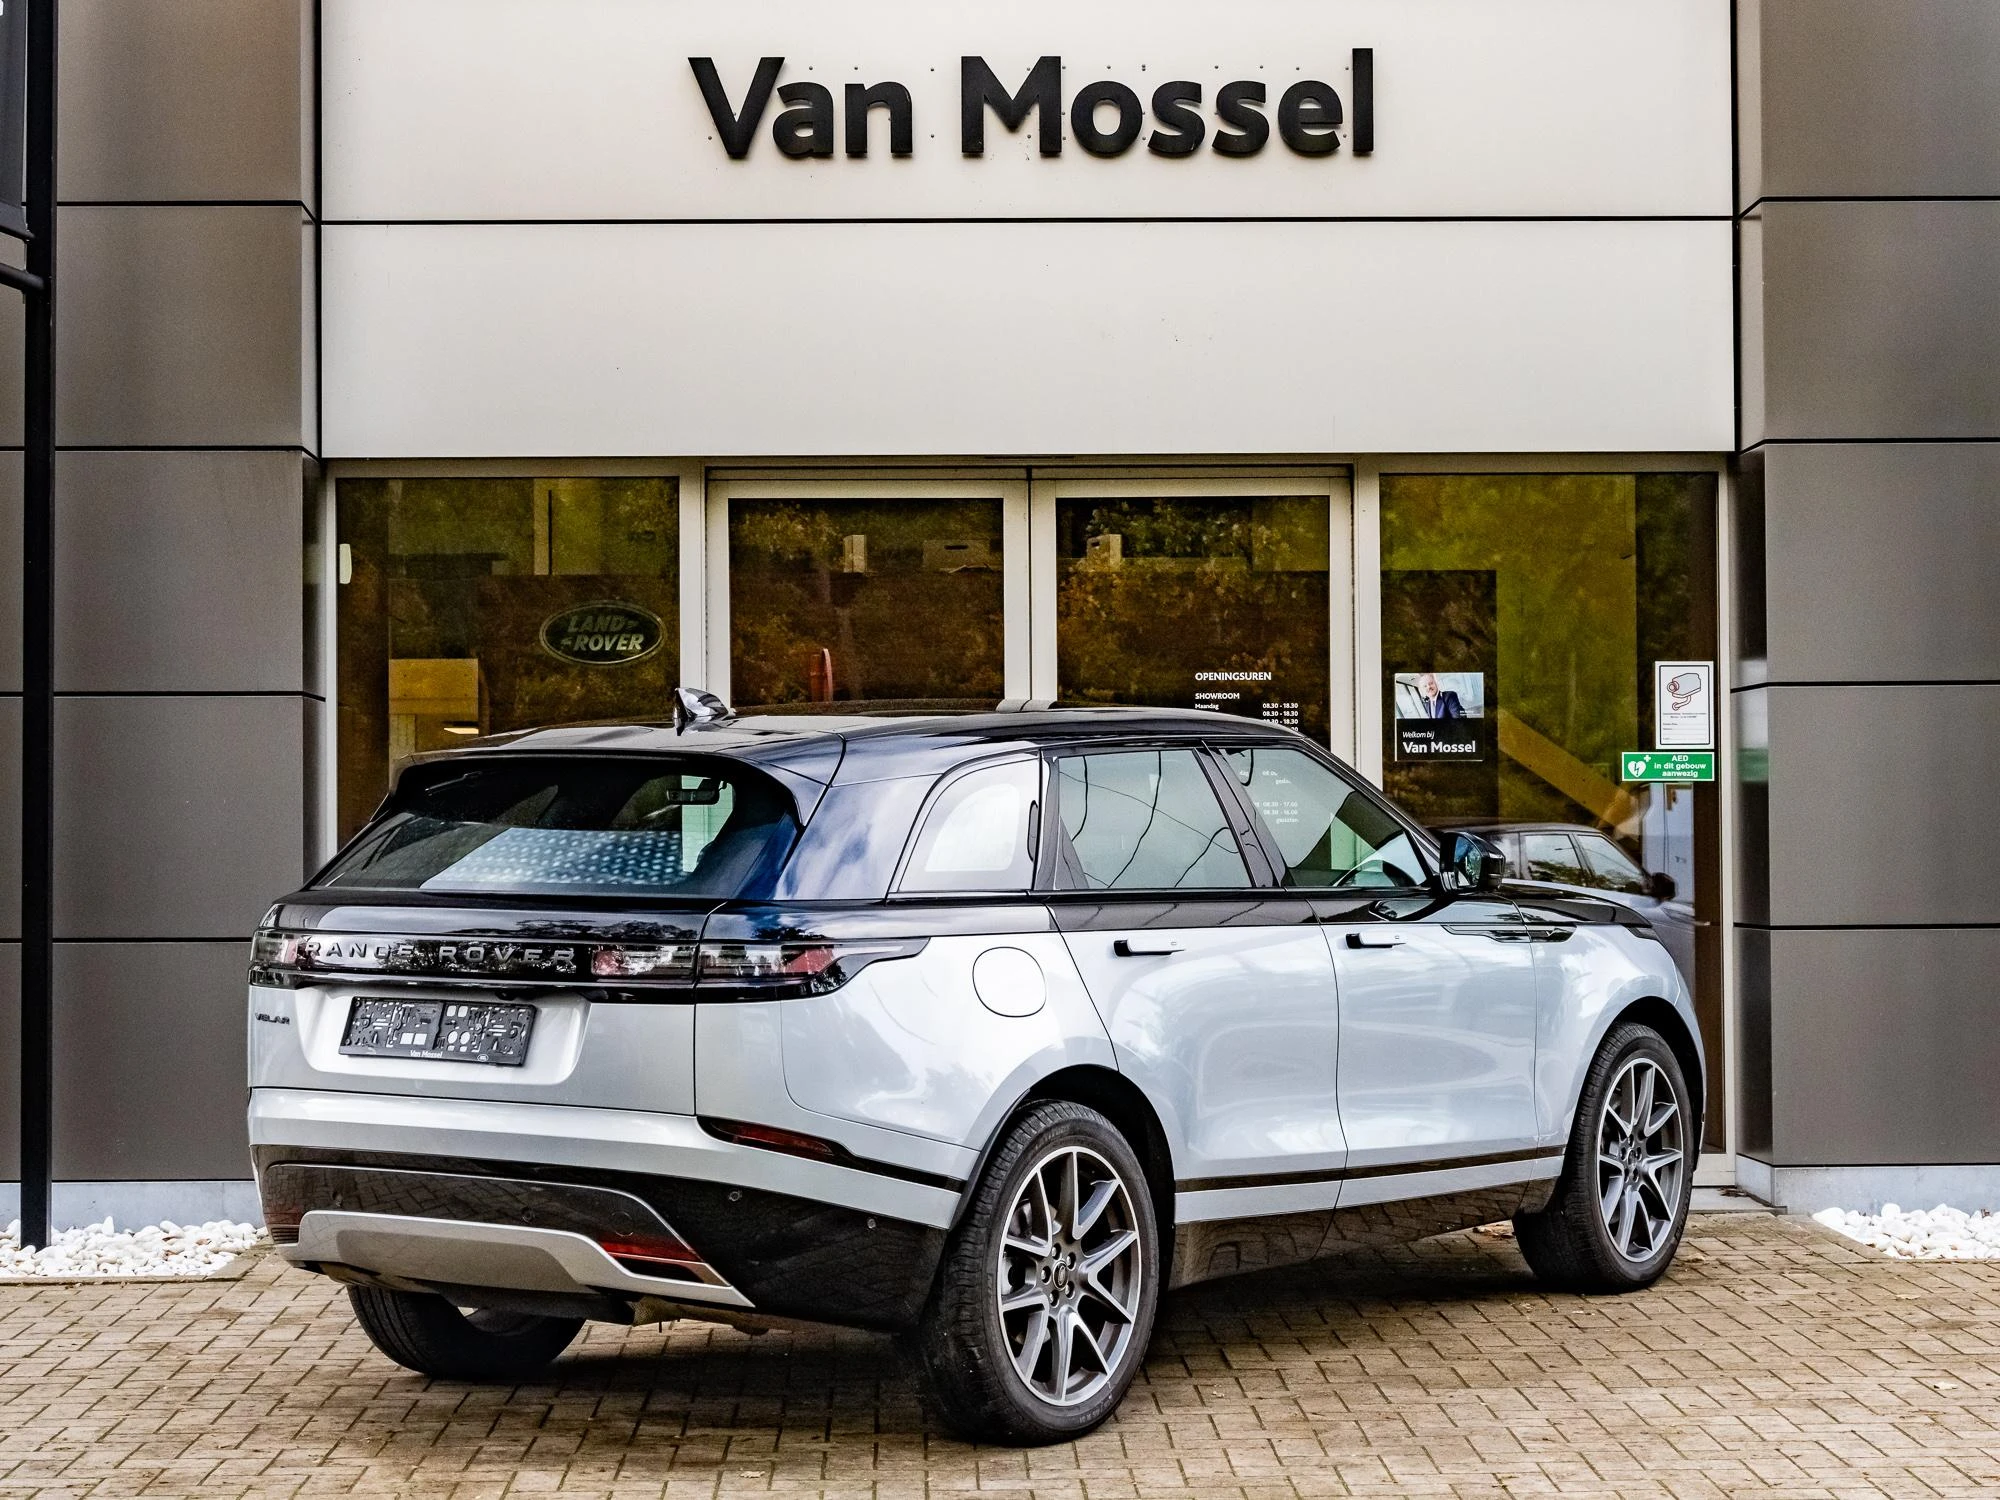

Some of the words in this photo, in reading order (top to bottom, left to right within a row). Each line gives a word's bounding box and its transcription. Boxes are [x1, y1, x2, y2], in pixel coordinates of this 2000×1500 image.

[687, 55, 914, 158] Van
[961, 47, 1374, 158] Mossel
[567, 615, 625, 632] LAND
[573, 633, 645, 651] ROVER
[1194, 671, 1272, 681] OPENINGSUREN
[1194, 692, 1240, 700] SHOWROOM
[1402, 731, 1426, 739] Welkom
[1426, 731, 1435, 740] bij
[1402, 741, 1428, 753] Van
[1430, 740, 1476, 753] Mossel
[1671, 754, 1689, 762] AED
[1675, 763, 1706, 771] gebouw
[1662, 770, 1699, 778] aanwezig
[304, 942, 415, 960] RANGE
[438, 946, 577, 967] ROVER
[254, 1013, 290, 1025] VELAR
[410, 1050, 421, 1058] Van
[421, 1050, 443, 1059] Mossel
